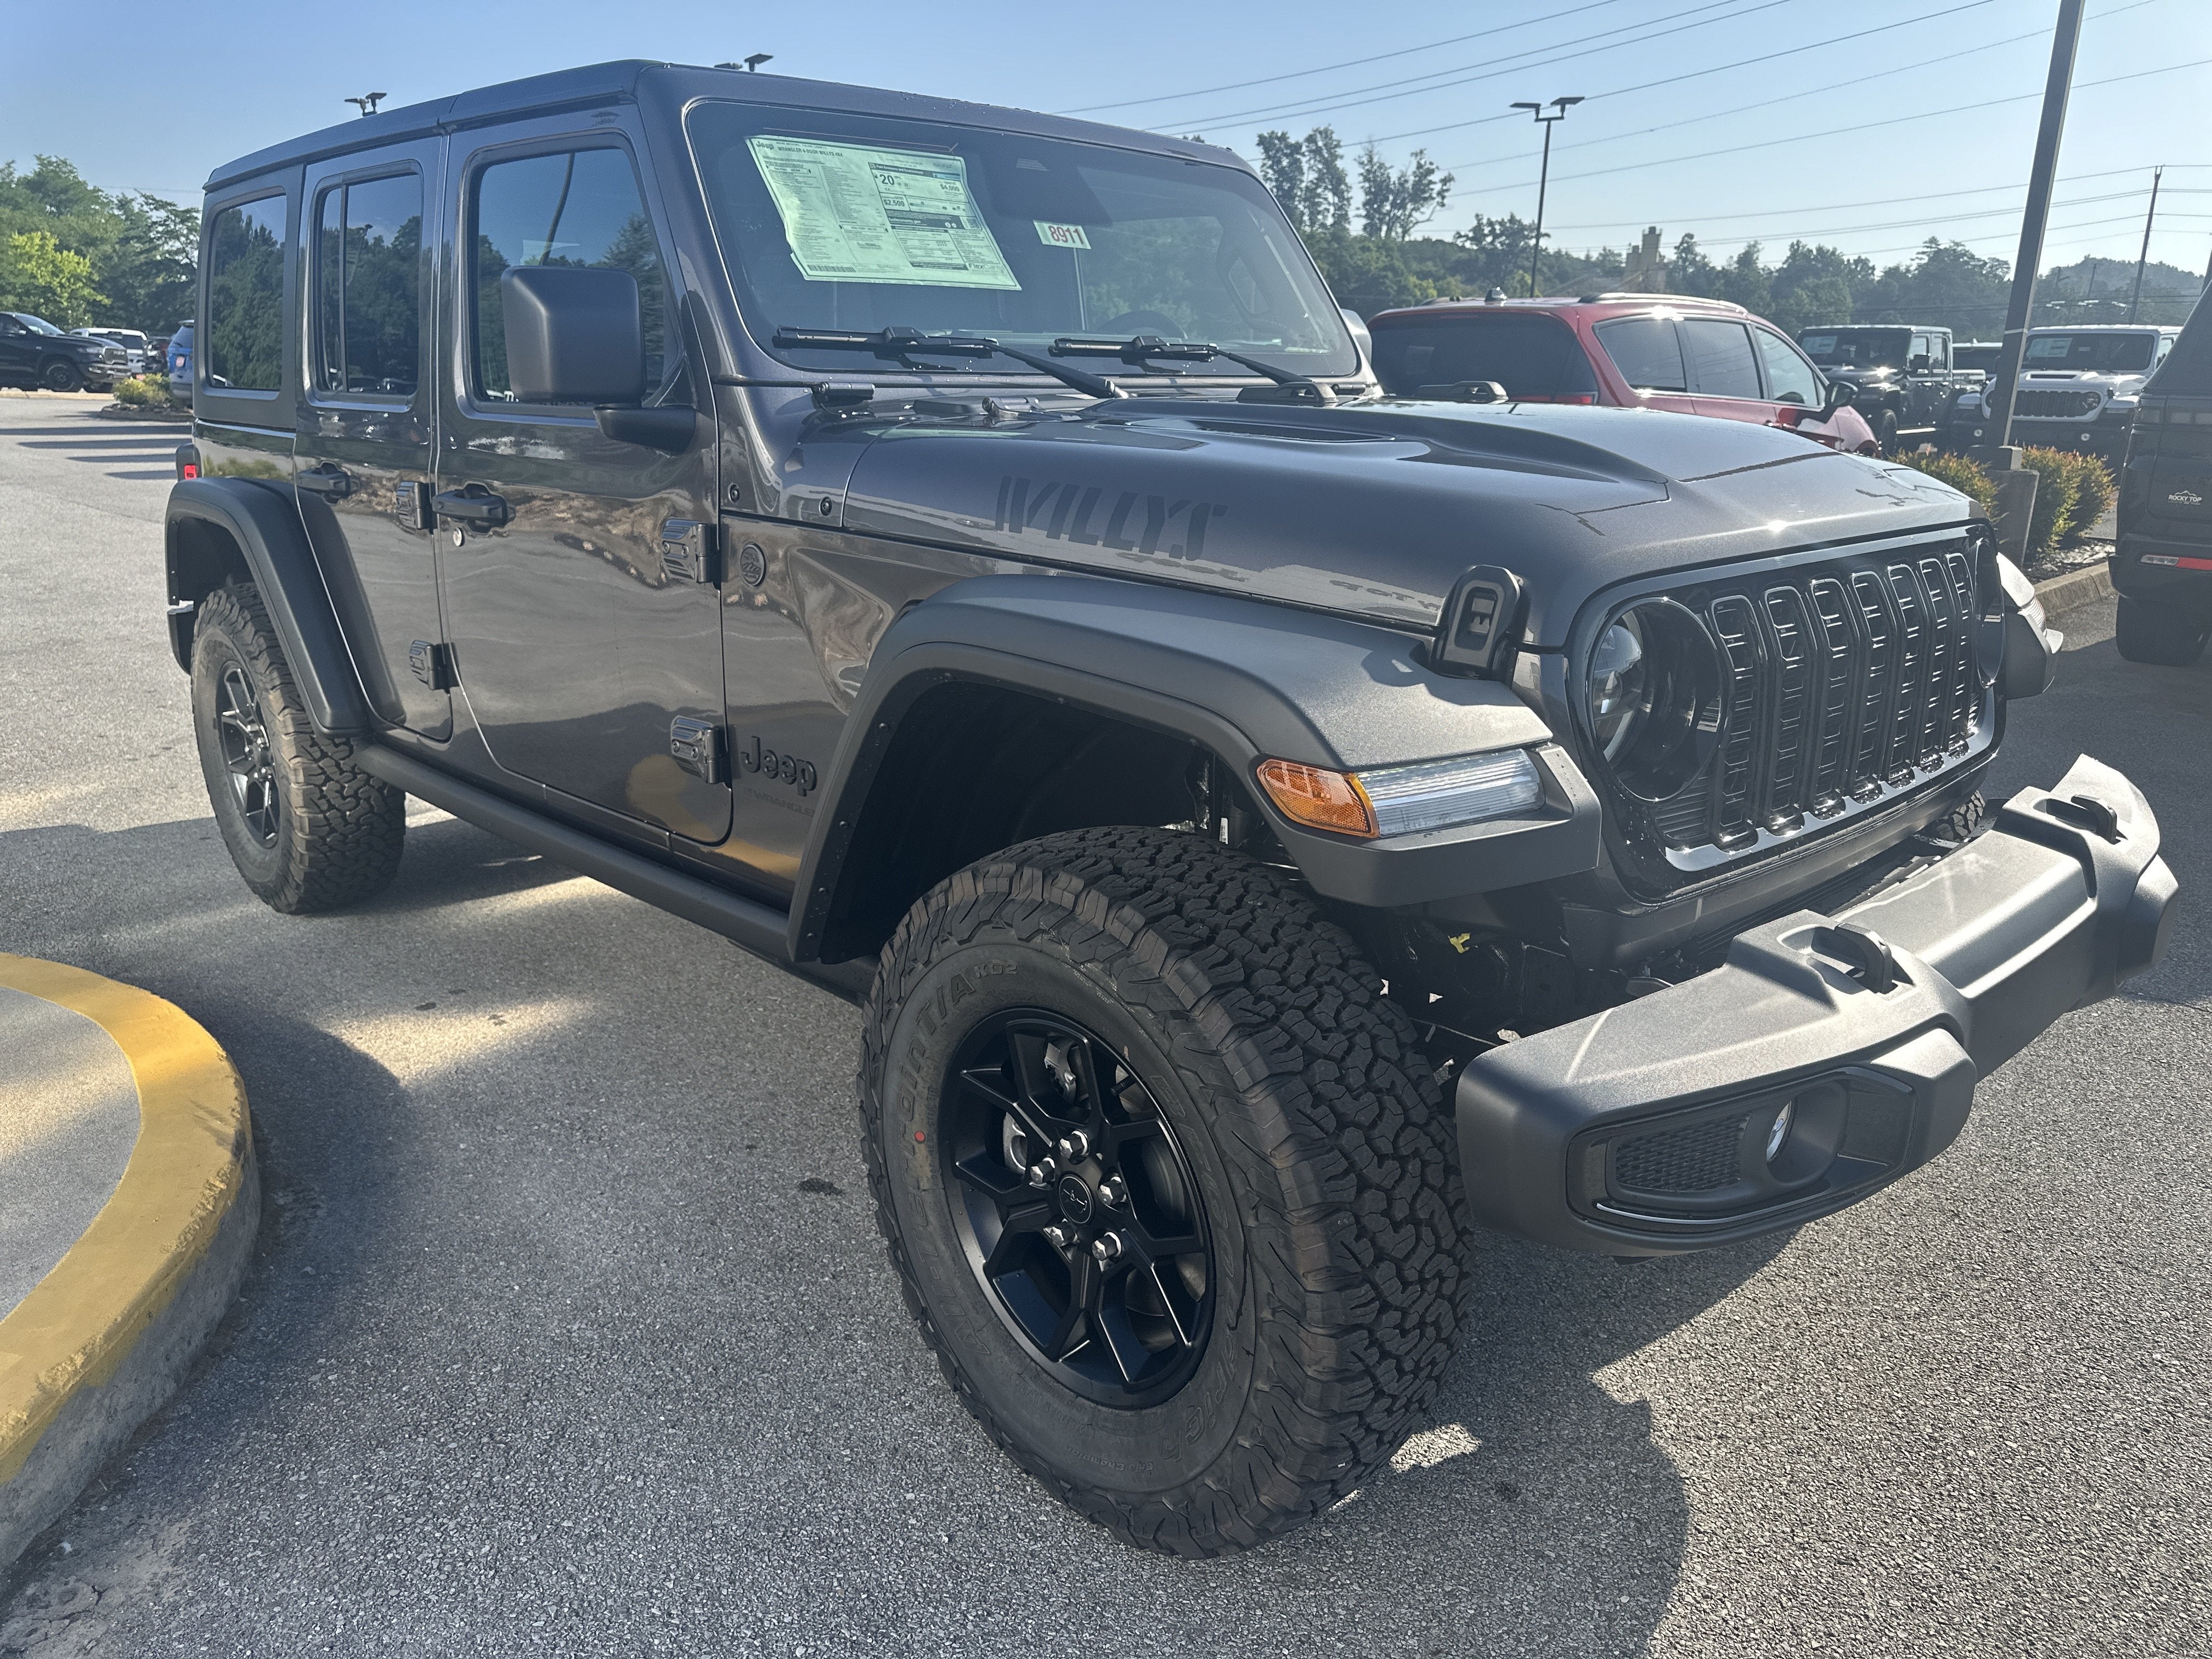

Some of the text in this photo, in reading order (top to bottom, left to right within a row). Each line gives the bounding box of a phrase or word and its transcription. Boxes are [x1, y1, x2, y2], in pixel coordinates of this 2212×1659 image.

[756, 140, 774, 150] Jeep
[879, 174, 895, 185] 20
[1048, 225, 1084, 245] 8911
[995, 476, 1229, 561] WILLYS
[741, 736, 817, 797] Jeep
[974, 958, 1018, 979] KO2
[1065, 1444, 1126, 1471] Champion
